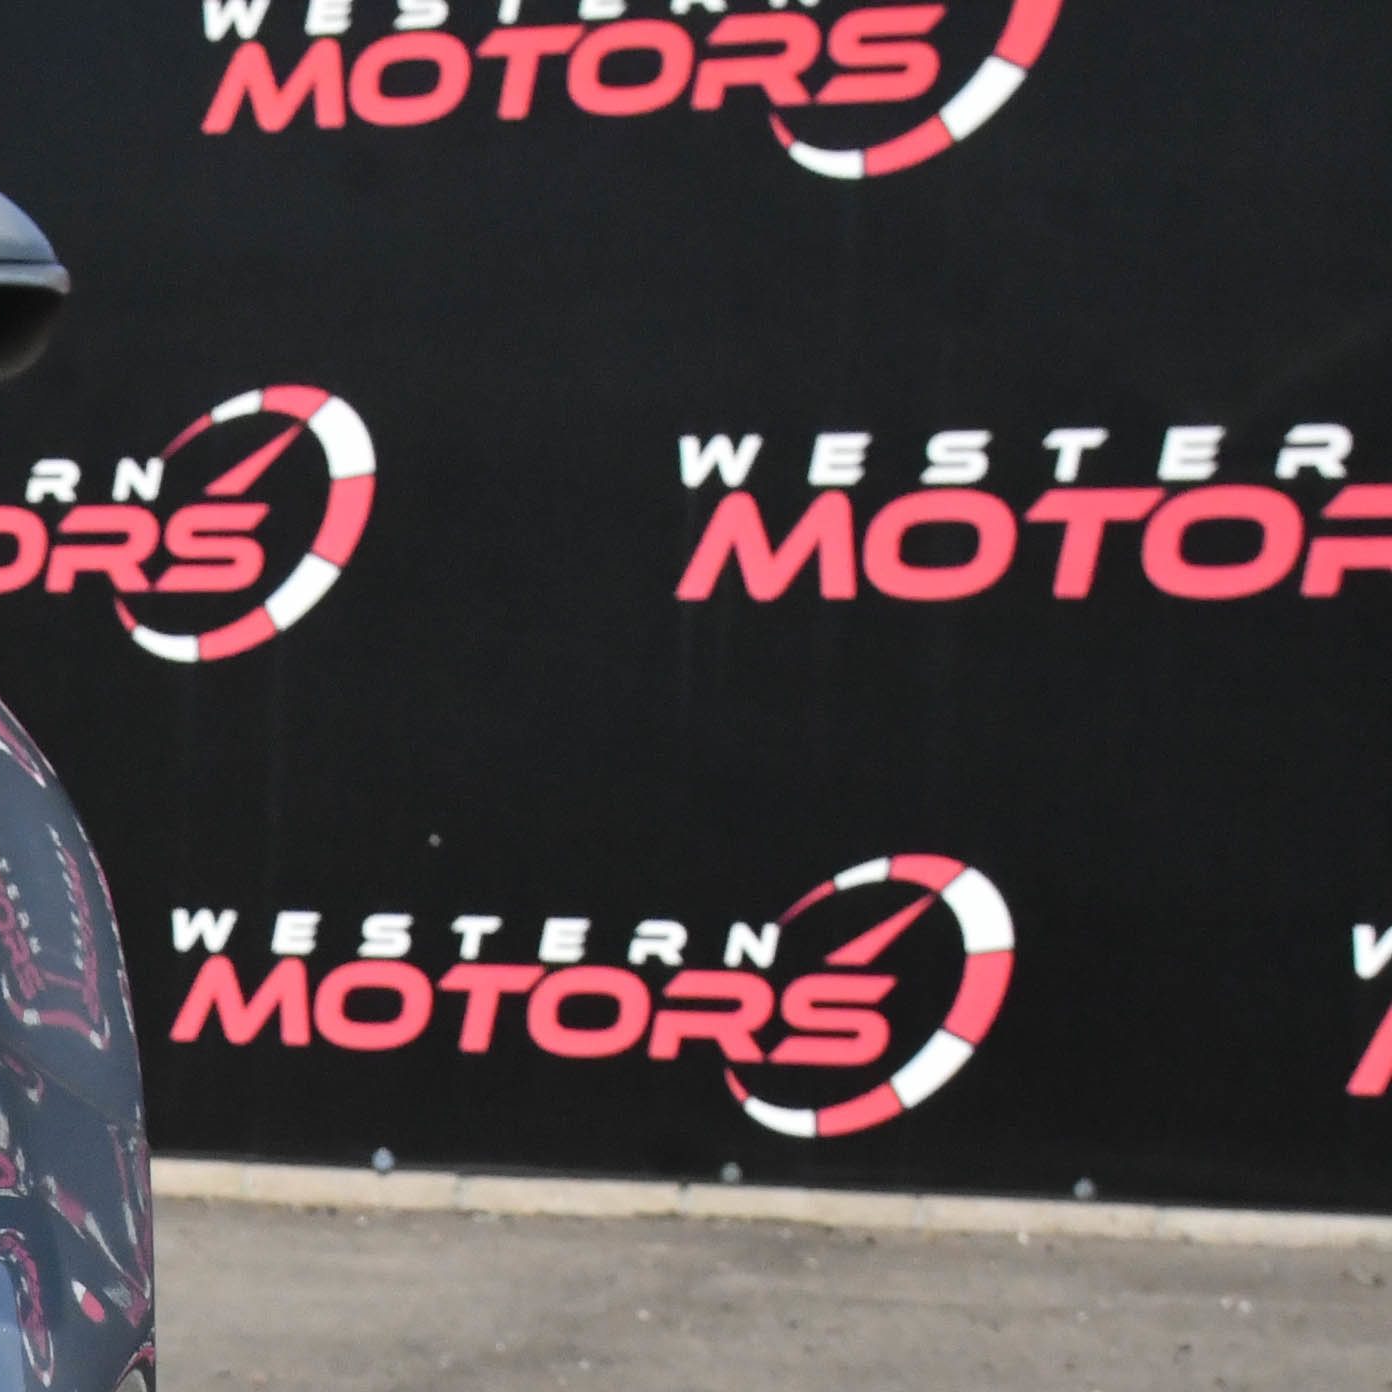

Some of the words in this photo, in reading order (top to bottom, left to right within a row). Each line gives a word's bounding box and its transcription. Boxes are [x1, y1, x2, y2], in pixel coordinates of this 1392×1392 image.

[200, 4, 946, 135] MOTORS
[677, 423, 1355, 490] WESTER
[170, 906, 783, 970] WESTERN
[169, 953, 897, 1067] MOTORS
